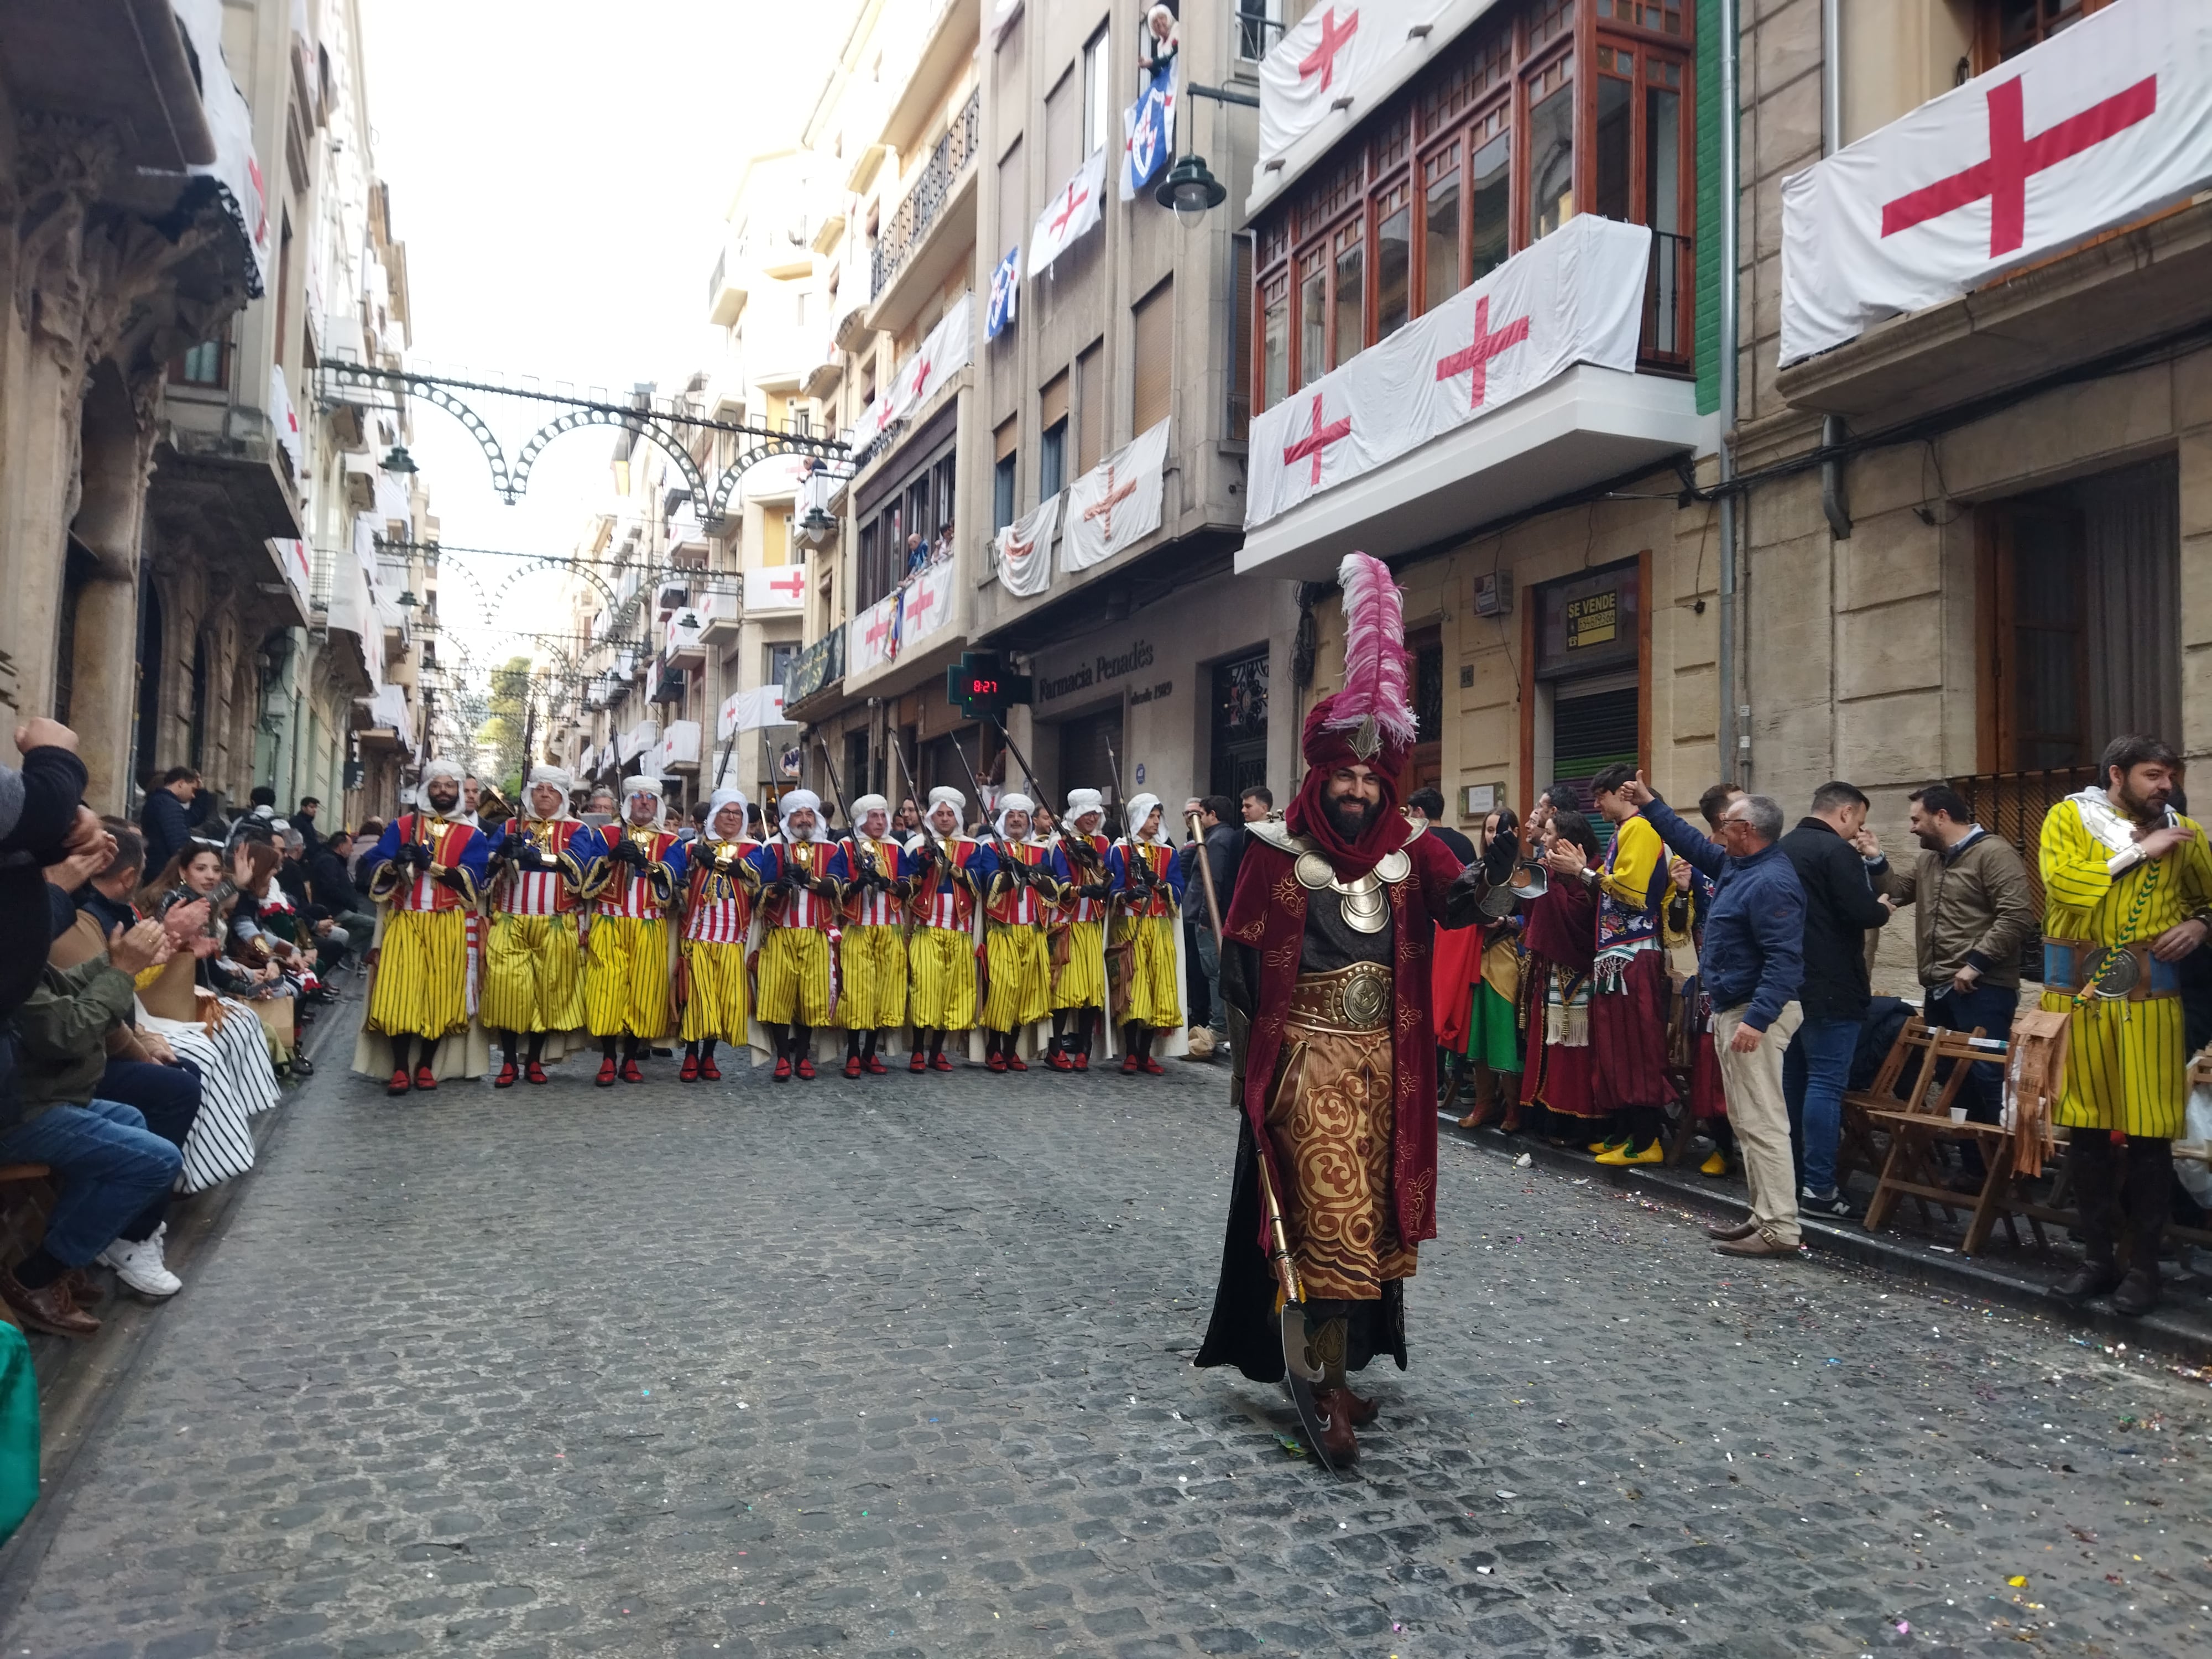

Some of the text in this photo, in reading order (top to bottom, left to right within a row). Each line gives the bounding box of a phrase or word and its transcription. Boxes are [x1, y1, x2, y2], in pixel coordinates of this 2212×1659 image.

[1568, 593, 1615, 618] SE VENDE
[1039, 639, 1154, 703] Farmacia Penadés
[973, 680, 997, 692] 8:27
